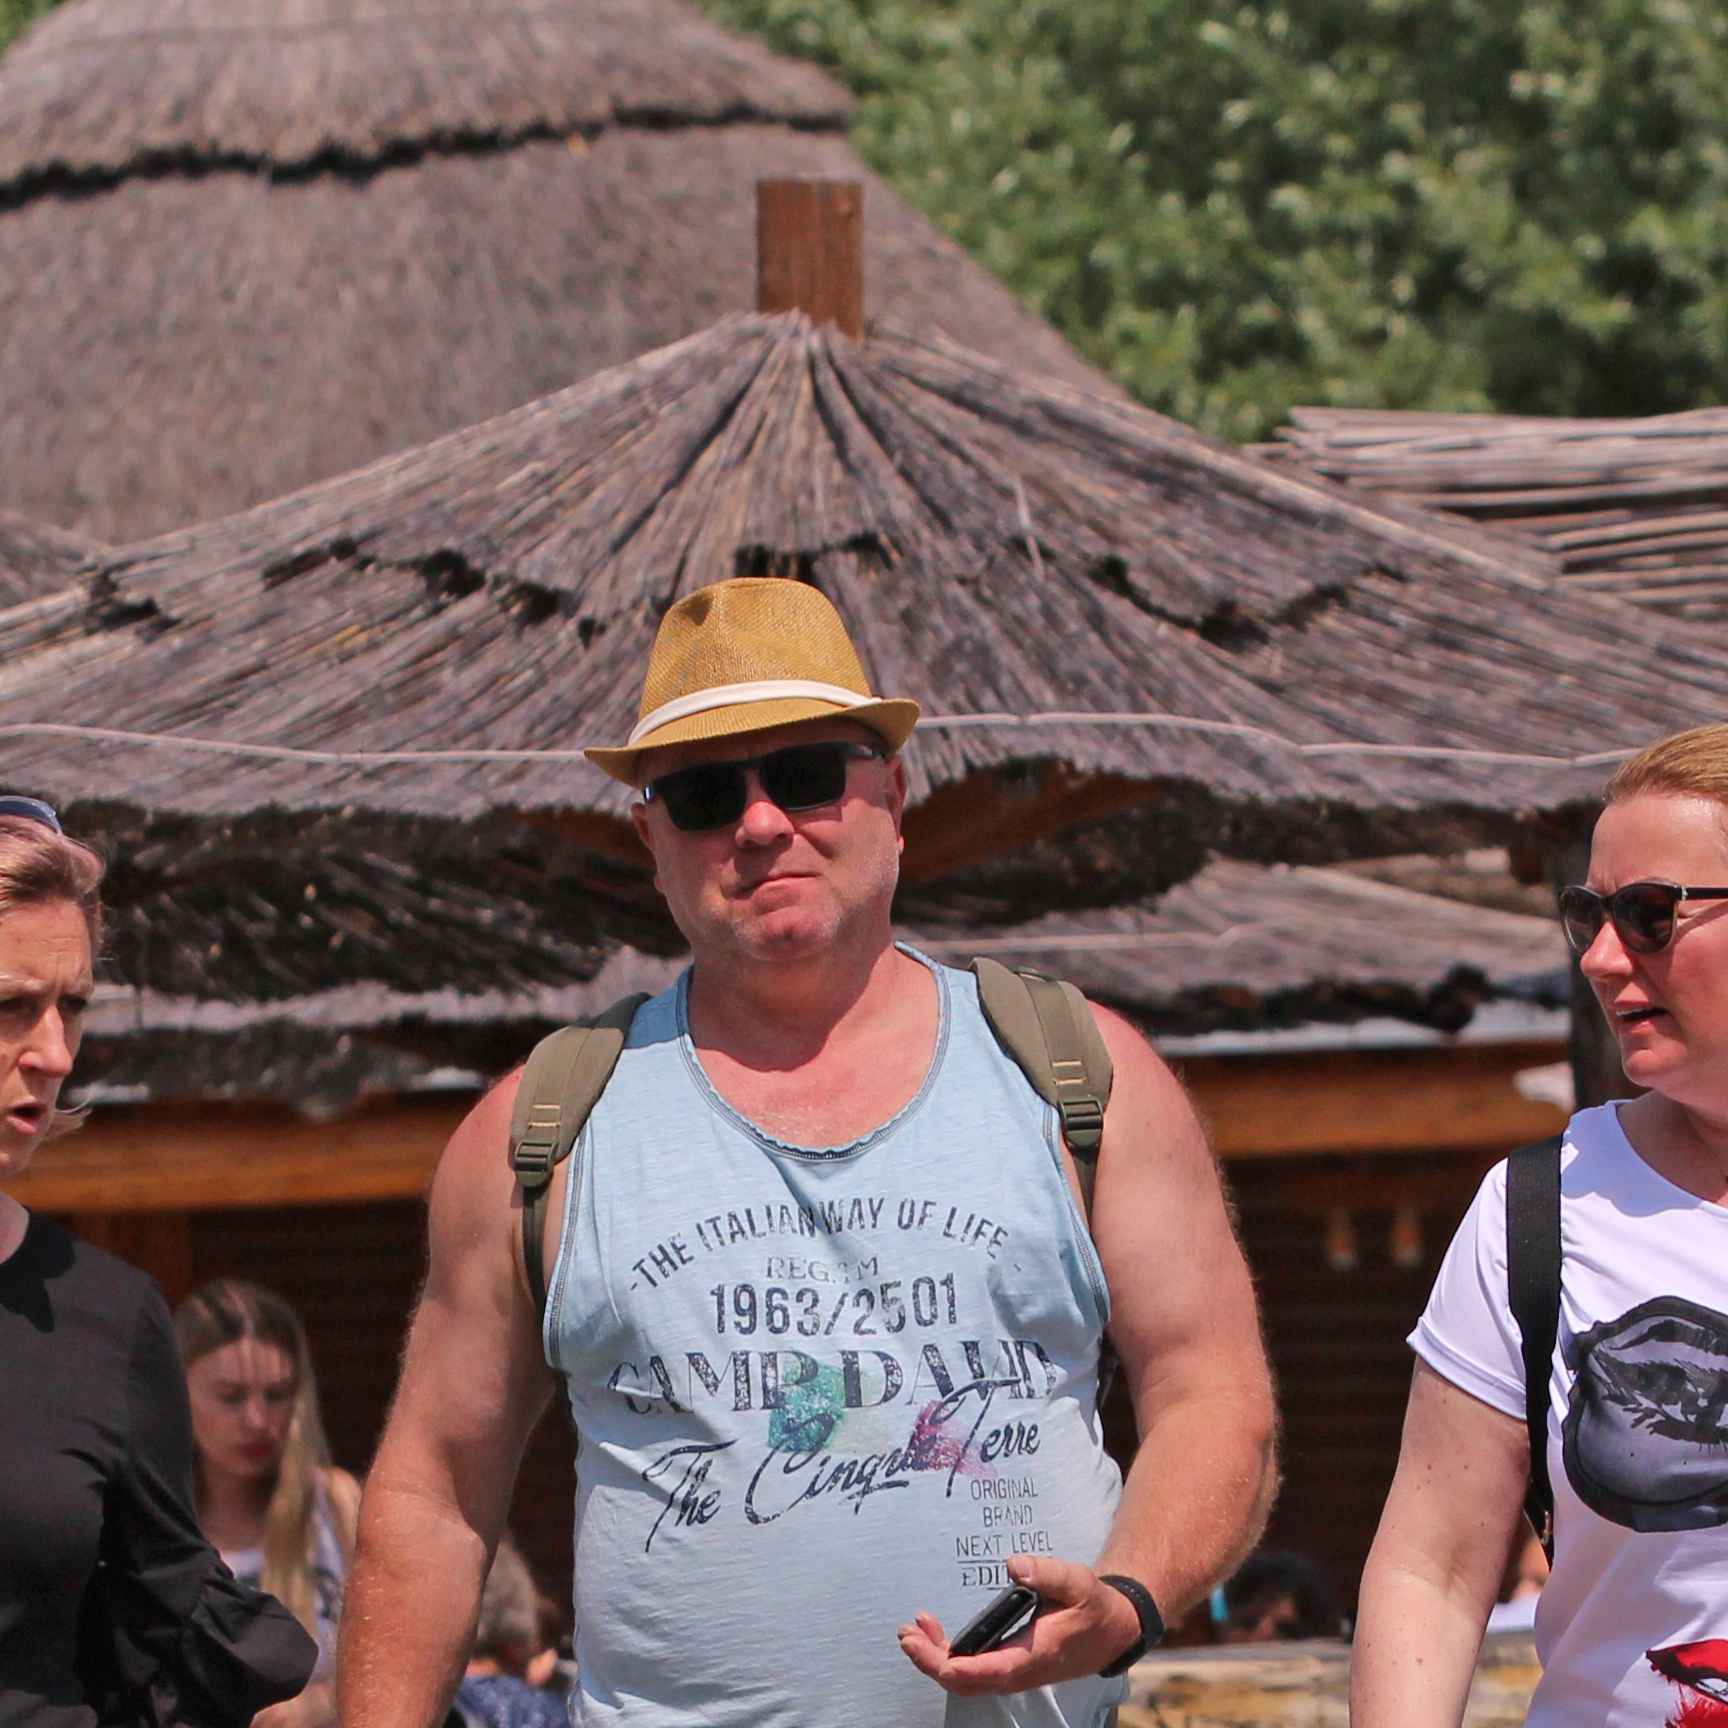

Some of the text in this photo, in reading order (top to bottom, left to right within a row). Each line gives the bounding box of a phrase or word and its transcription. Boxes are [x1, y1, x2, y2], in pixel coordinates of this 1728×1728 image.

[695, 1204, 817, 1252] ITALIAN
[817, 1197, 886, 1236] WAY
[896, 1197, 937, 1231] OF
[709, 1271, 958, 1337] 1963/2501
[607, 1338, 1058, 1415] CAMP DAVID
[641, 1439, 738, 1553] The
[927, 1377, 1040, 1498] Terre
[970, 1477, 1039, 1500] ORIGINAL
[956, 1530, 1054, 1557] NEXT LEVEL
[983, 1504, 1033, 1528] BRAND
